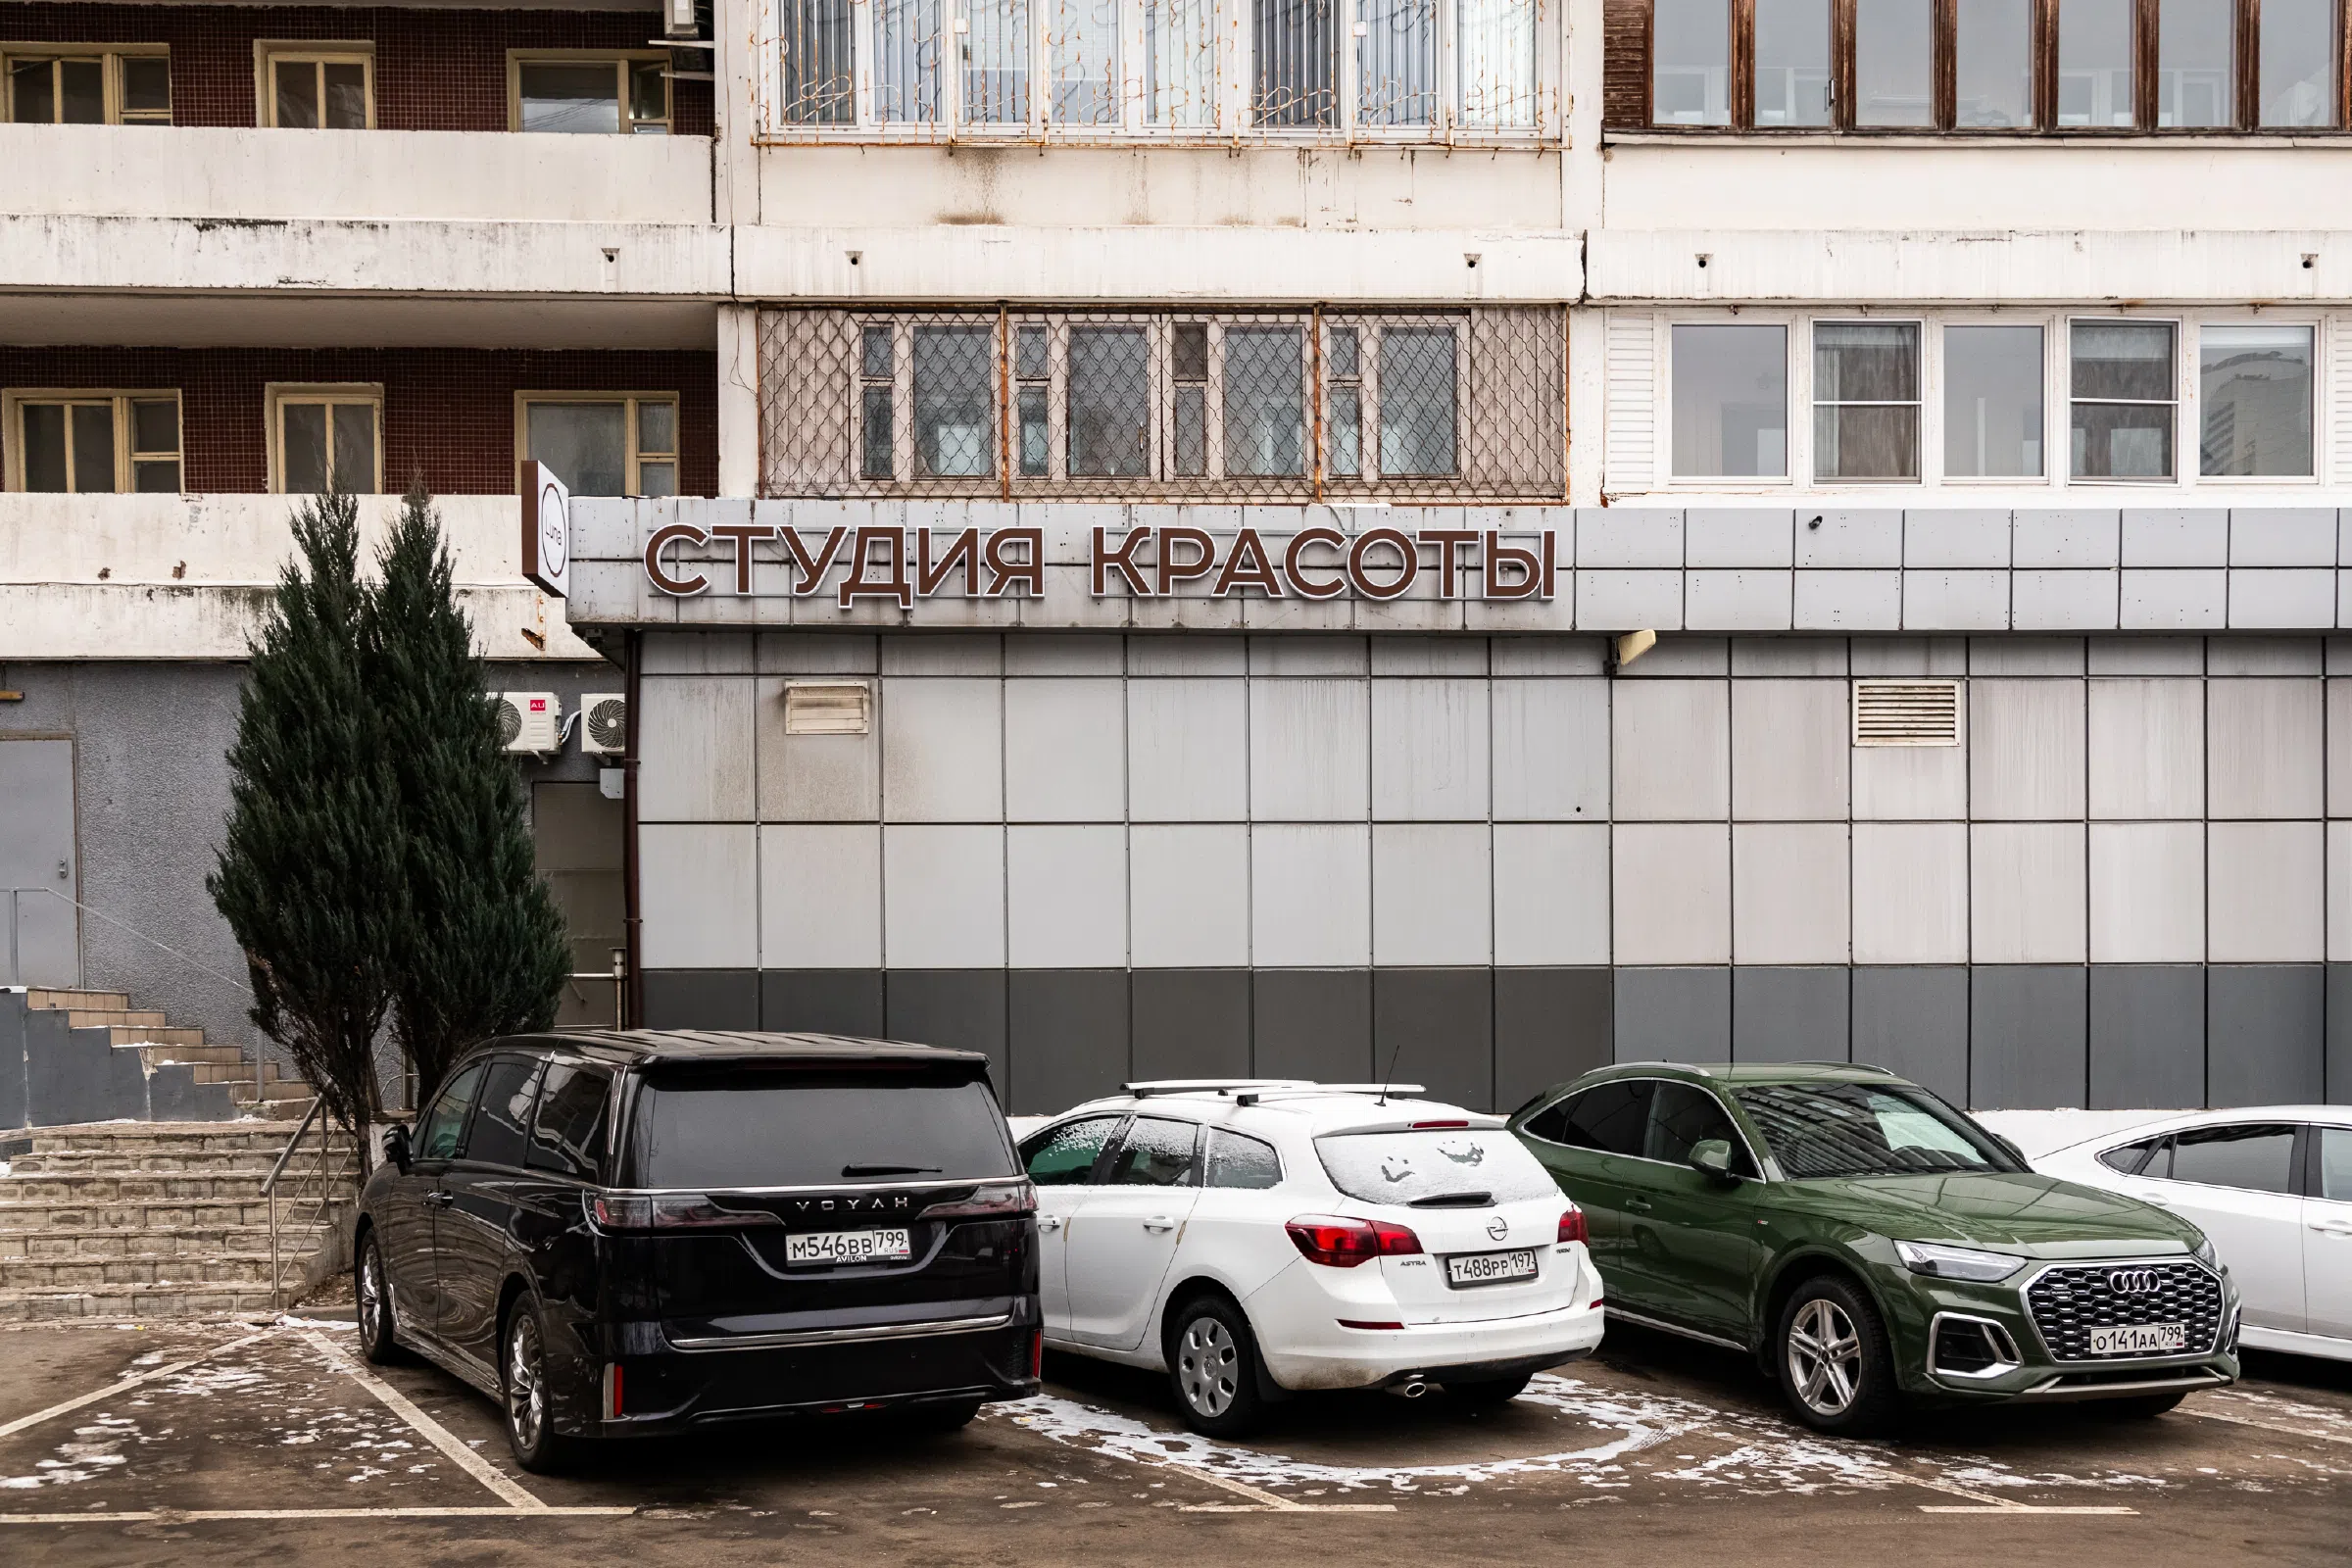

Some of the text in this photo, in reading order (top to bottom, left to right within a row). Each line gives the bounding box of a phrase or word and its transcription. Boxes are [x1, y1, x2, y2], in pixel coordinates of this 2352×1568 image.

[644, 522, 1557, 610] СТУДИЯ КРАСОТЫ
[796, 1197, 907, 1211] VOYAH
[875, 1231, 905, 1249] 799
[836, 1254, 867, 1263] AVILON
[1511, 1251, 1531, 1268] 197
[2161, 1326, 2180, 1342] 799
